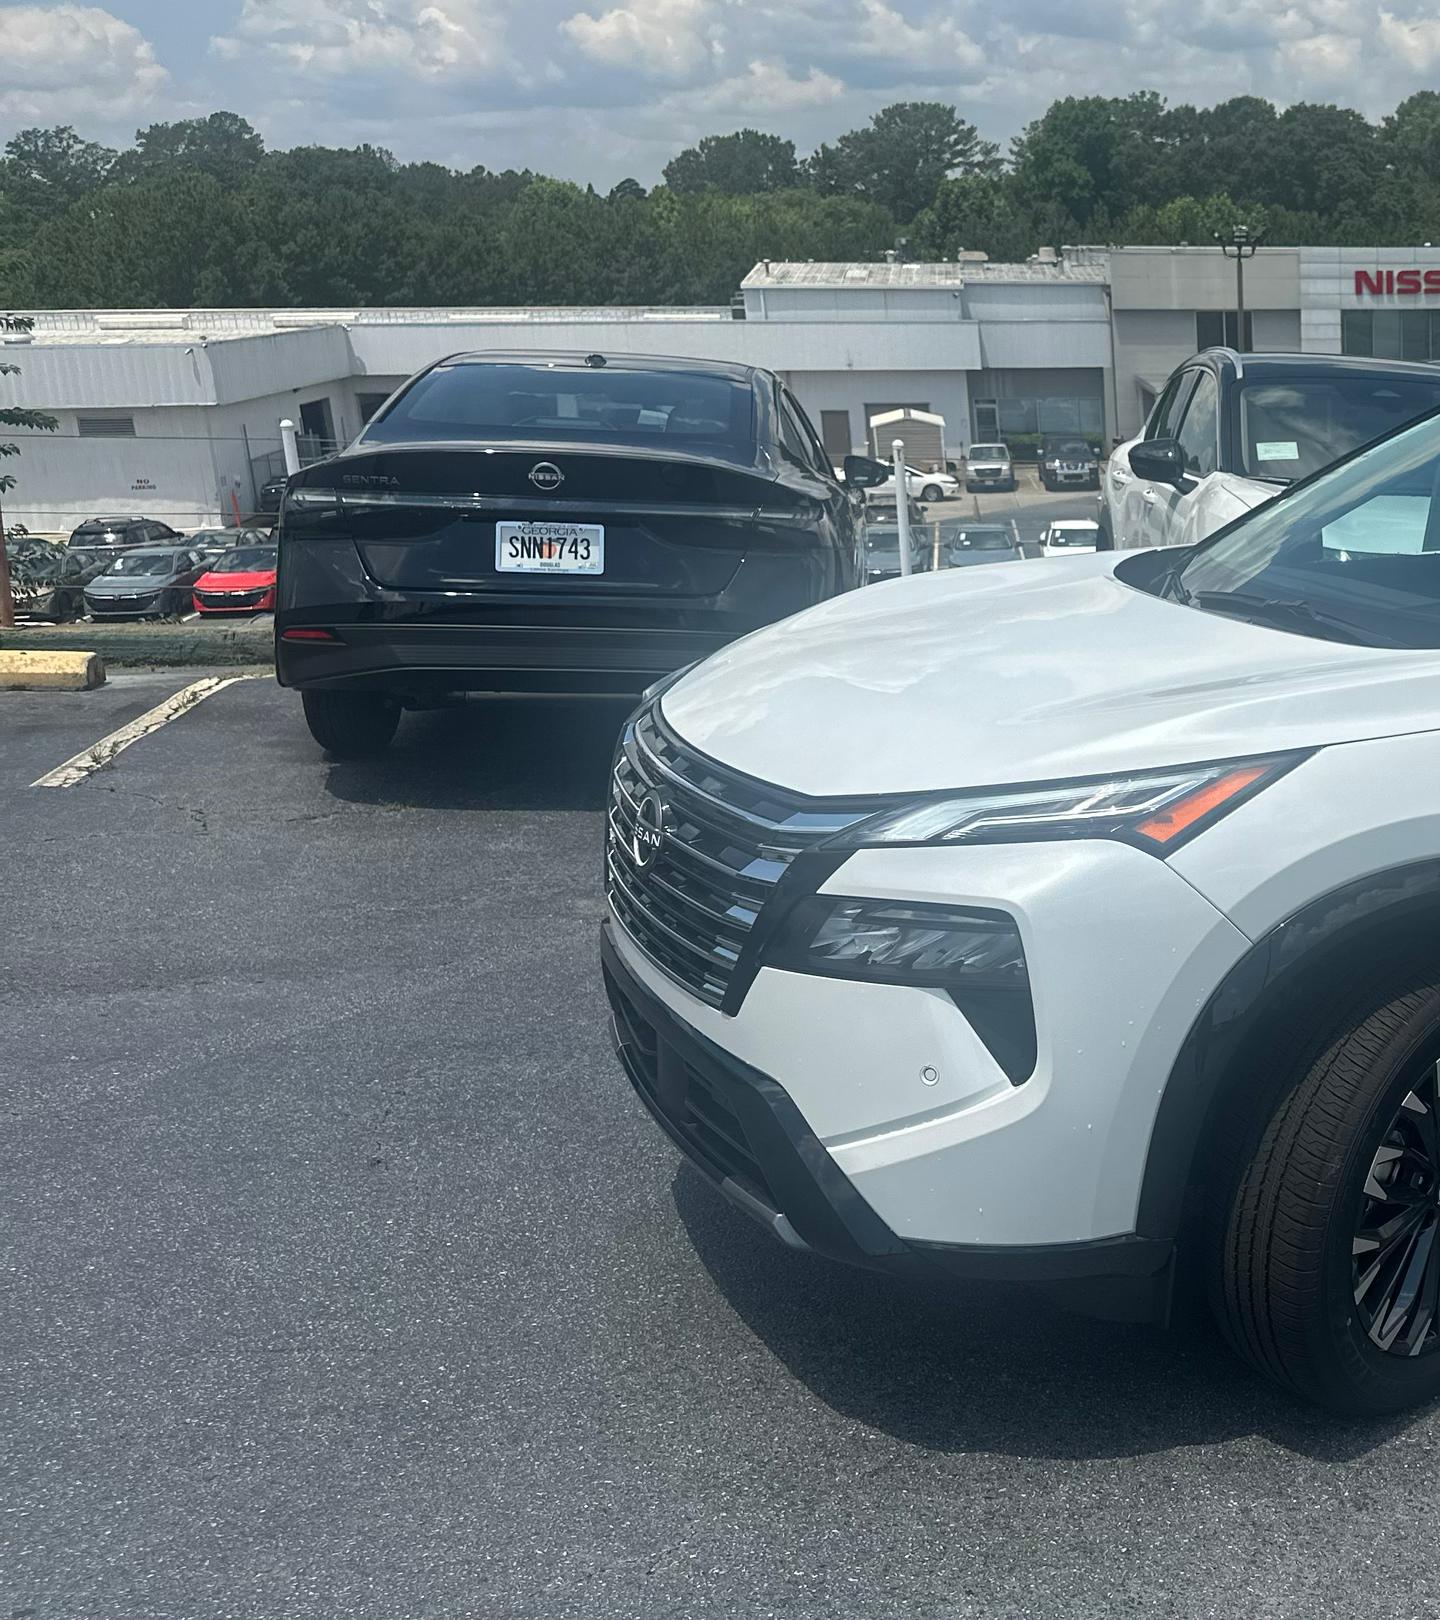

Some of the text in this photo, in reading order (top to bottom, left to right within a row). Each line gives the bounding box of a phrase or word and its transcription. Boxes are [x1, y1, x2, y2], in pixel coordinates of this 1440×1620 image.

[342, 474, 400, 486] SENTRA
[528, 472, 565, 481] NISSAN
[521, 526, 578, 536] GEORGIA
[508, 535, 591, 560] SNN1743
